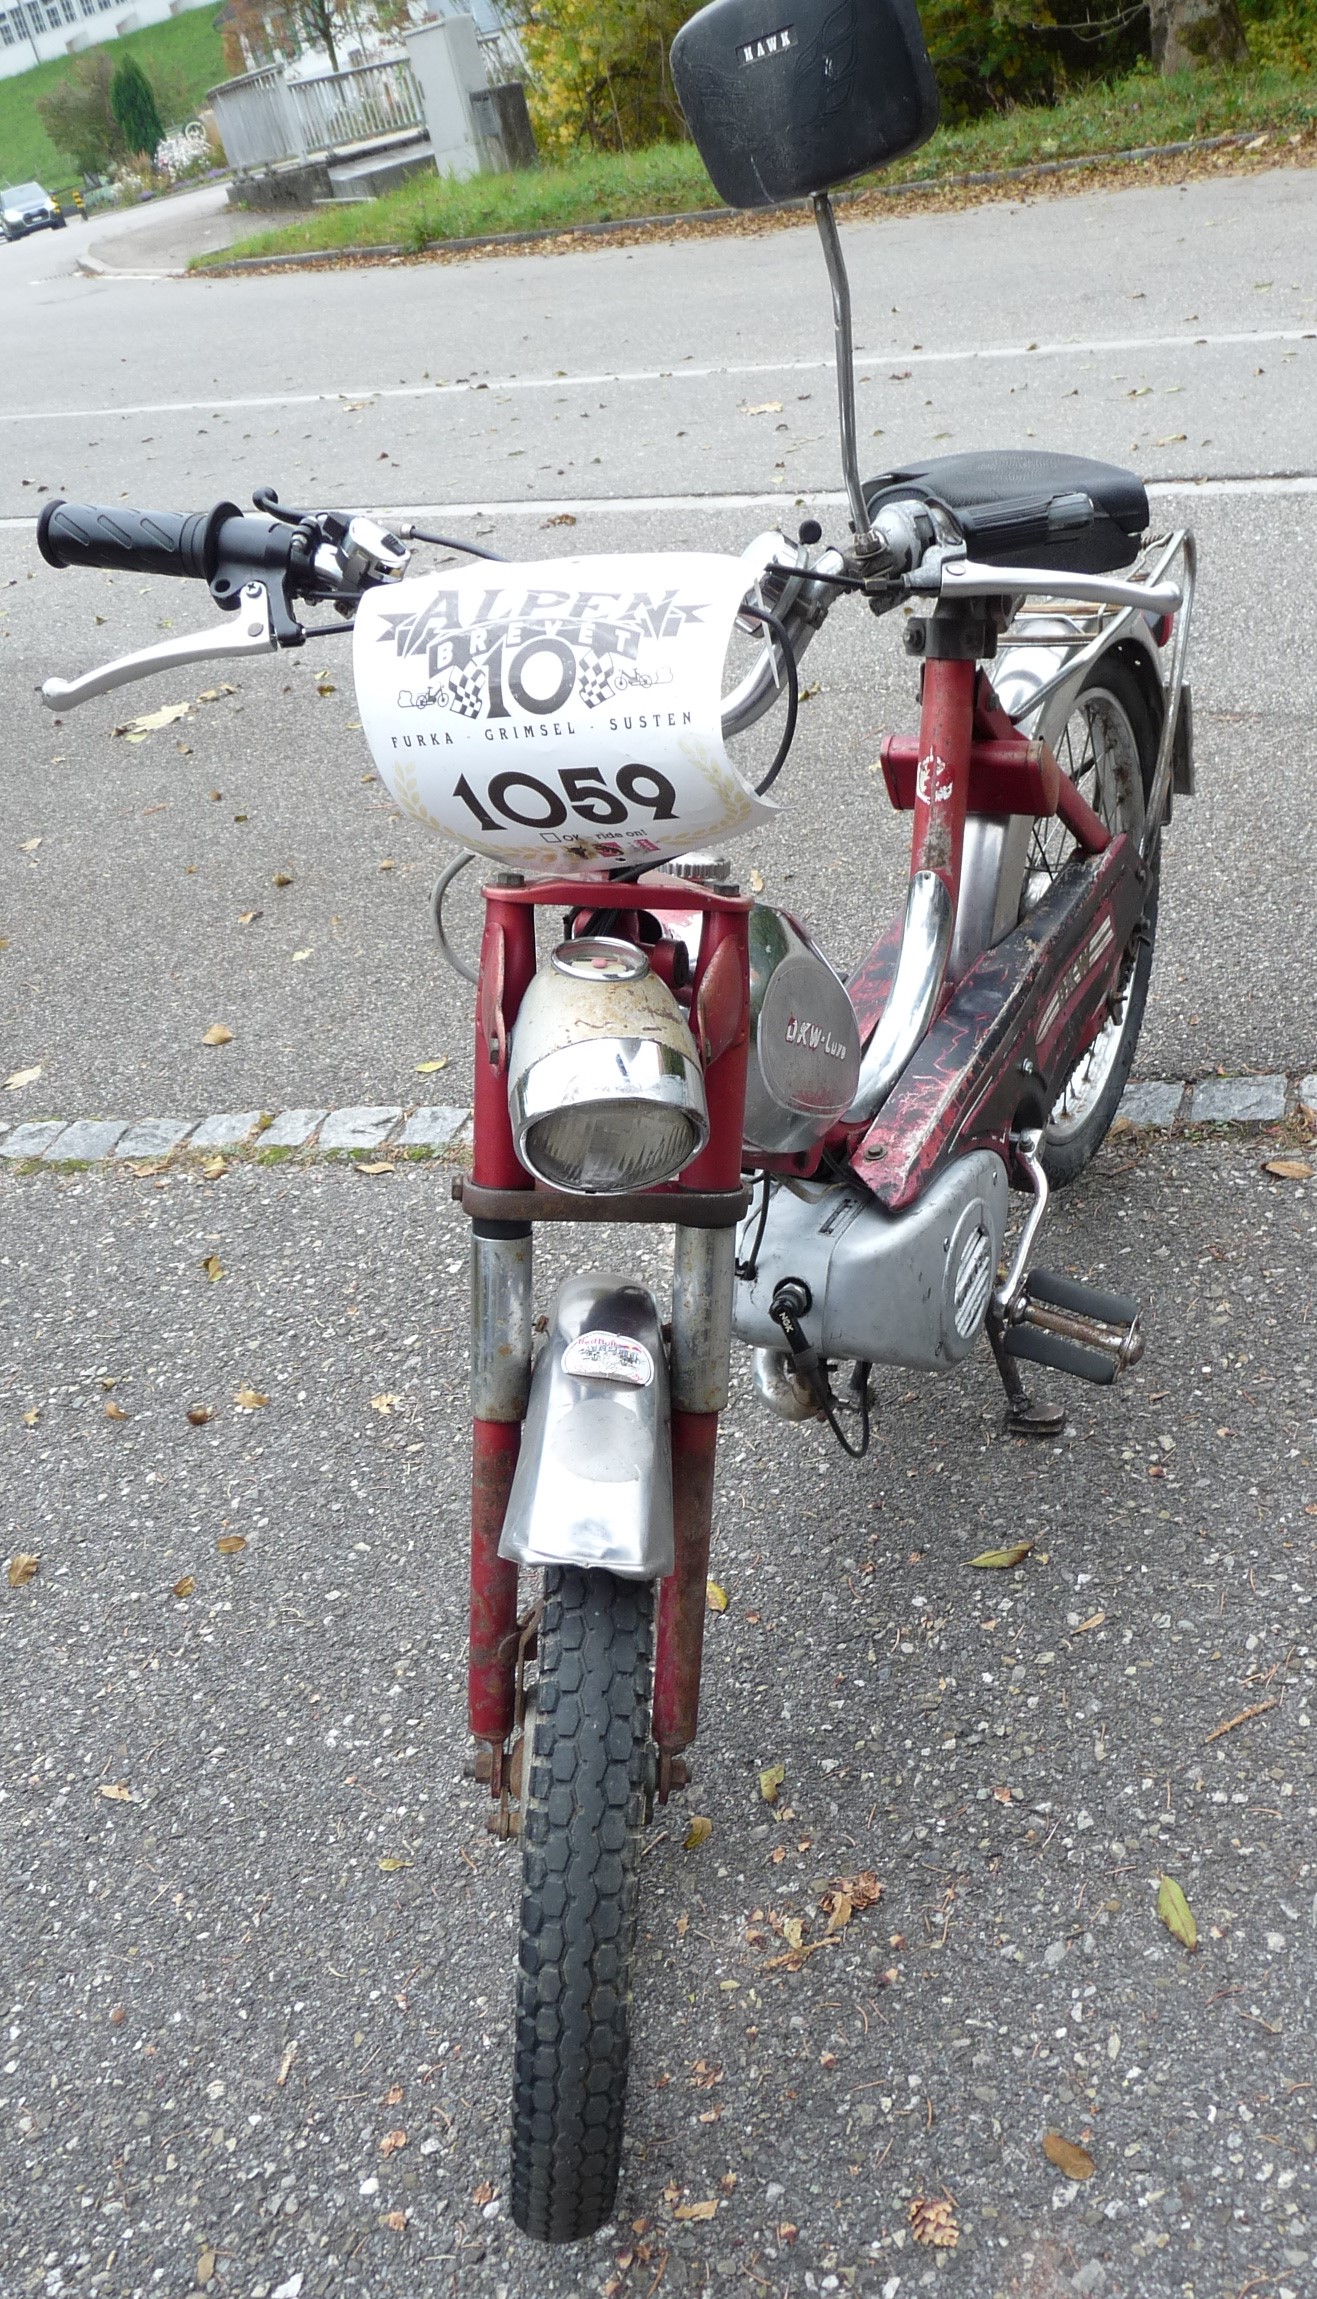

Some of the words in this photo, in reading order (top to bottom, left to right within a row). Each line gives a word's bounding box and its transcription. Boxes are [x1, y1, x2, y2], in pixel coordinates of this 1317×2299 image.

[743, 30, 790, 62] HAWK
[400, 588, 682, 659] ALPEN
[436, 620, 633, 670] BREVET
[474, 635, 577, 719] 10
[391, 731, 454, 749] FURKA
[484, 721, 576, 742] GRIMSEL
[609, 711, 693, 731] SUSTEN
[452, 763, 681, 831] 1059
[595, 831, 624, 840] ride
[625, 829, 648, 837] on!
